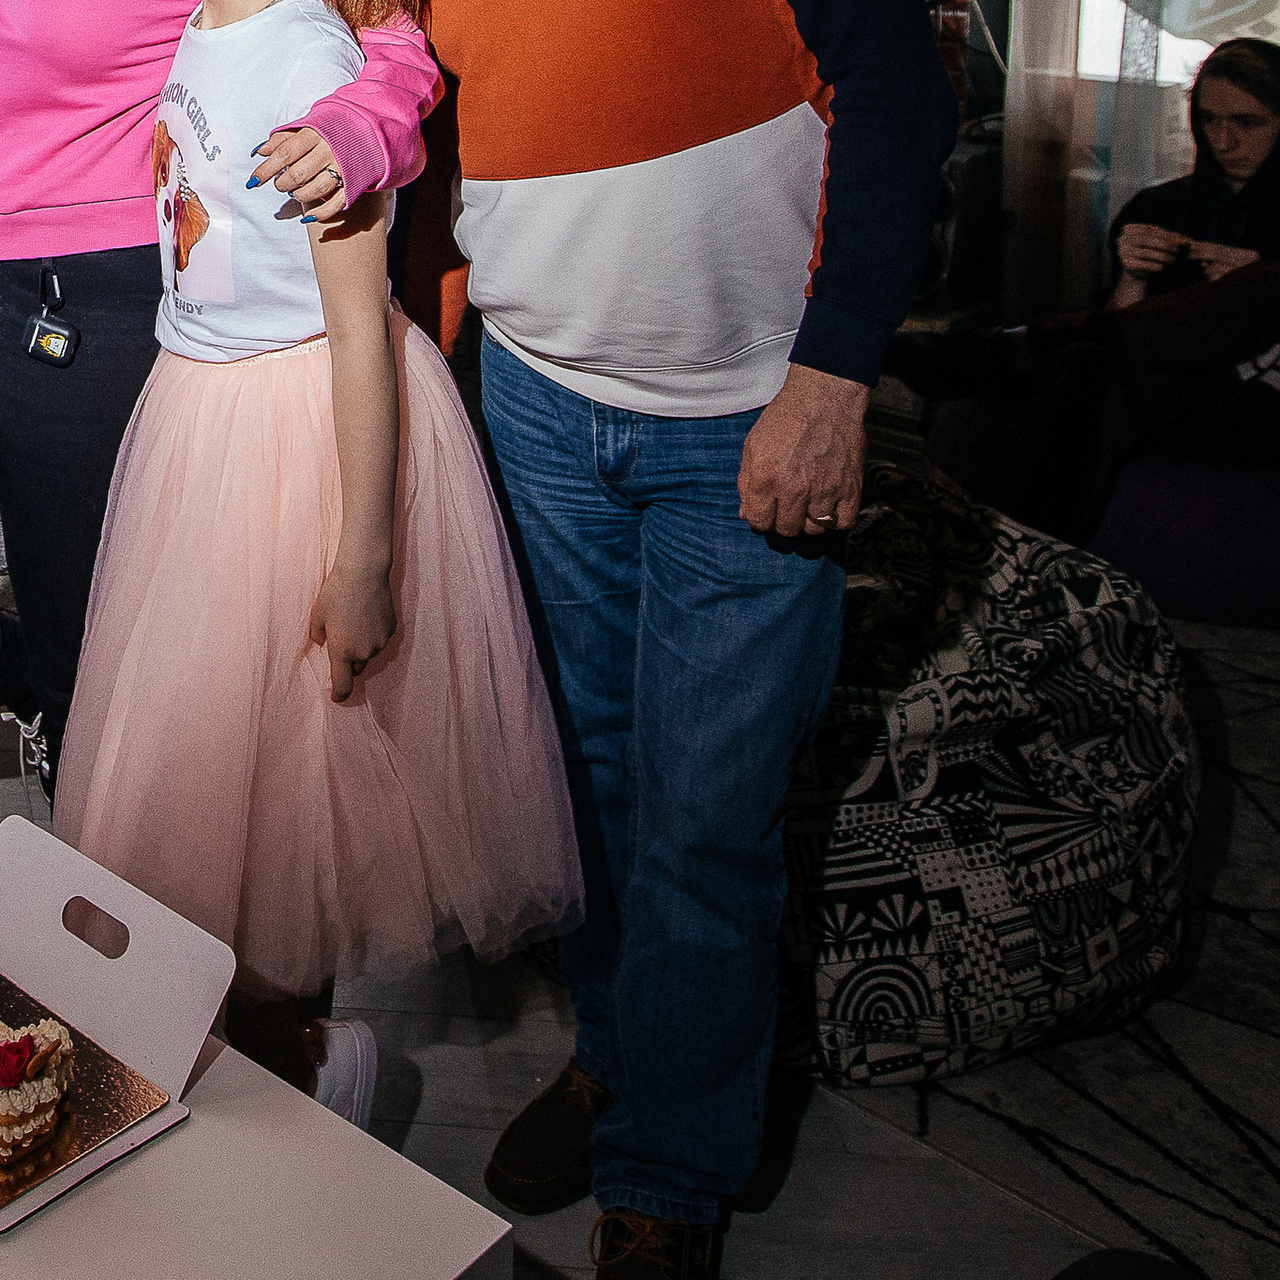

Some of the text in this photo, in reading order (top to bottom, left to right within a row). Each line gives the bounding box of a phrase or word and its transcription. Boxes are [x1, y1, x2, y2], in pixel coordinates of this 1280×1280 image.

[160, 82, 222, 162] HION GIRLS
[174, 294, 204, 316] ENDY
